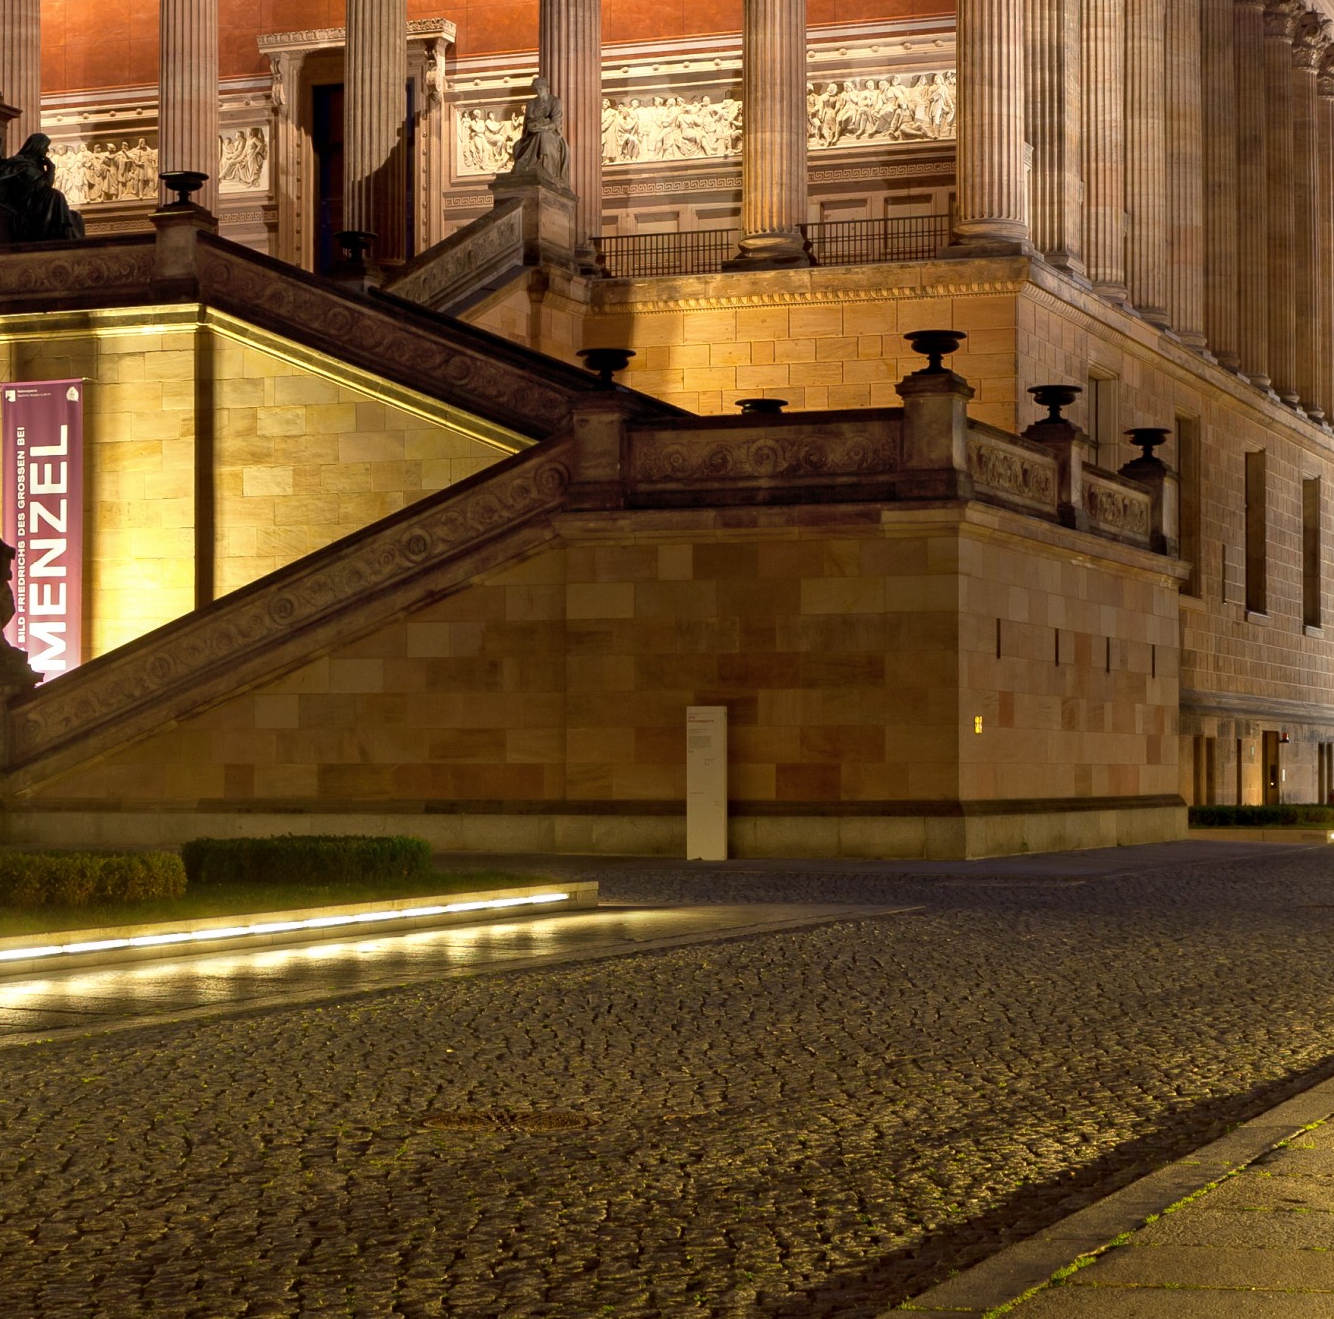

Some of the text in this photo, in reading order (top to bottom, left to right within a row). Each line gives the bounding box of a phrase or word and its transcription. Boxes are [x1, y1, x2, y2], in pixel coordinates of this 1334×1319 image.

[16, 427, 25, 446] BEI
[17, 450, 26, 509] GROSSEN
[17, 512, 26, 537] DES
[28, 424, 68, 671] MENZEL
[17, 540, 26, 612] FRIEDRICHS
[17, 617, 26, 643] BILD
